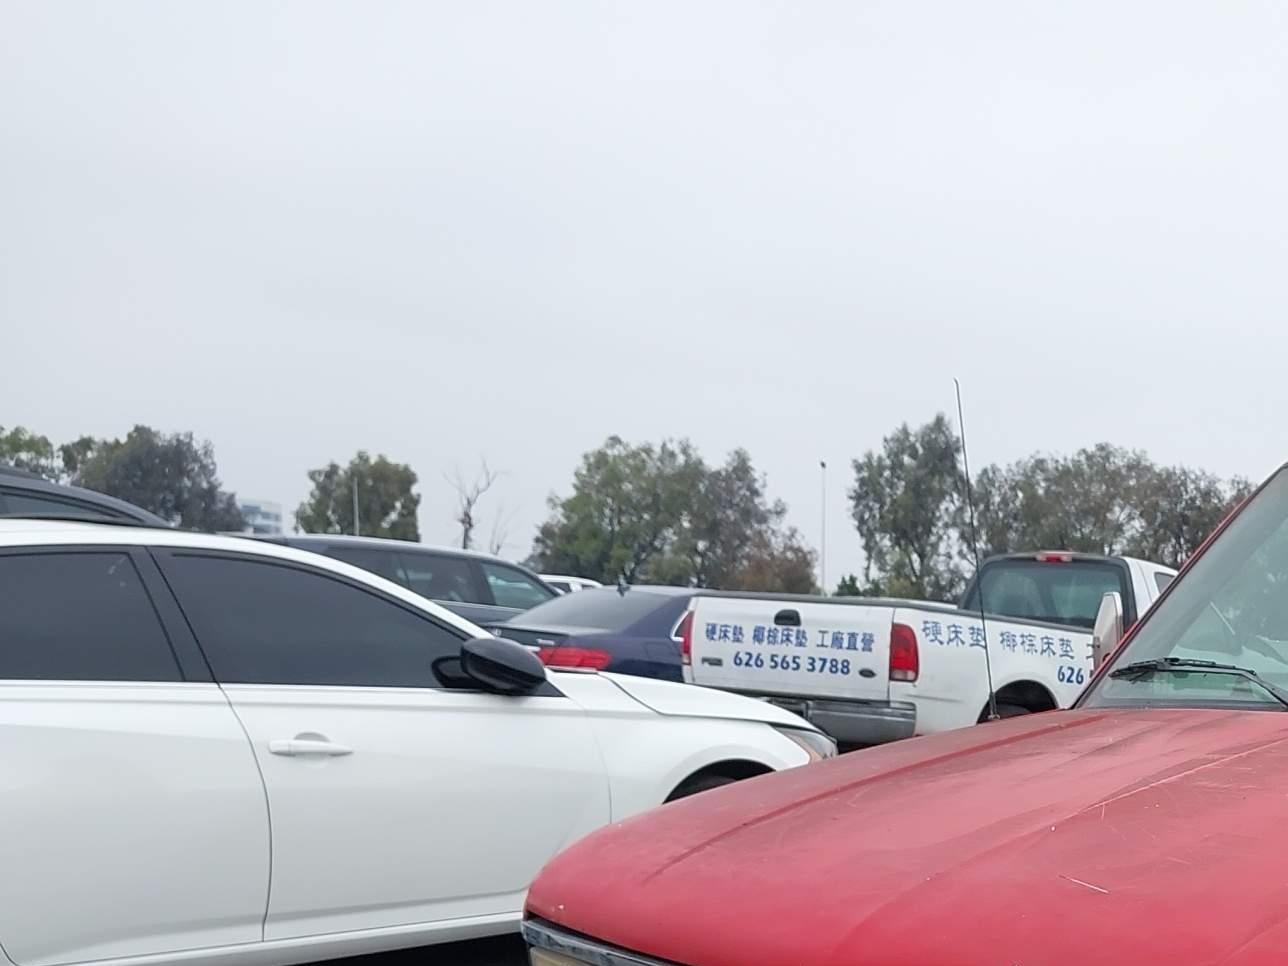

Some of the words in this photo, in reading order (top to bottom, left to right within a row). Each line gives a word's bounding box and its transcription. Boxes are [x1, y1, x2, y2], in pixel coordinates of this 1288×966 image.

[733, 651, 764, 669] 626
[769, 653, 801, 671] 565
[806, 656, 851, 676] 3788
[1057, 665, 1084, 685] 626
